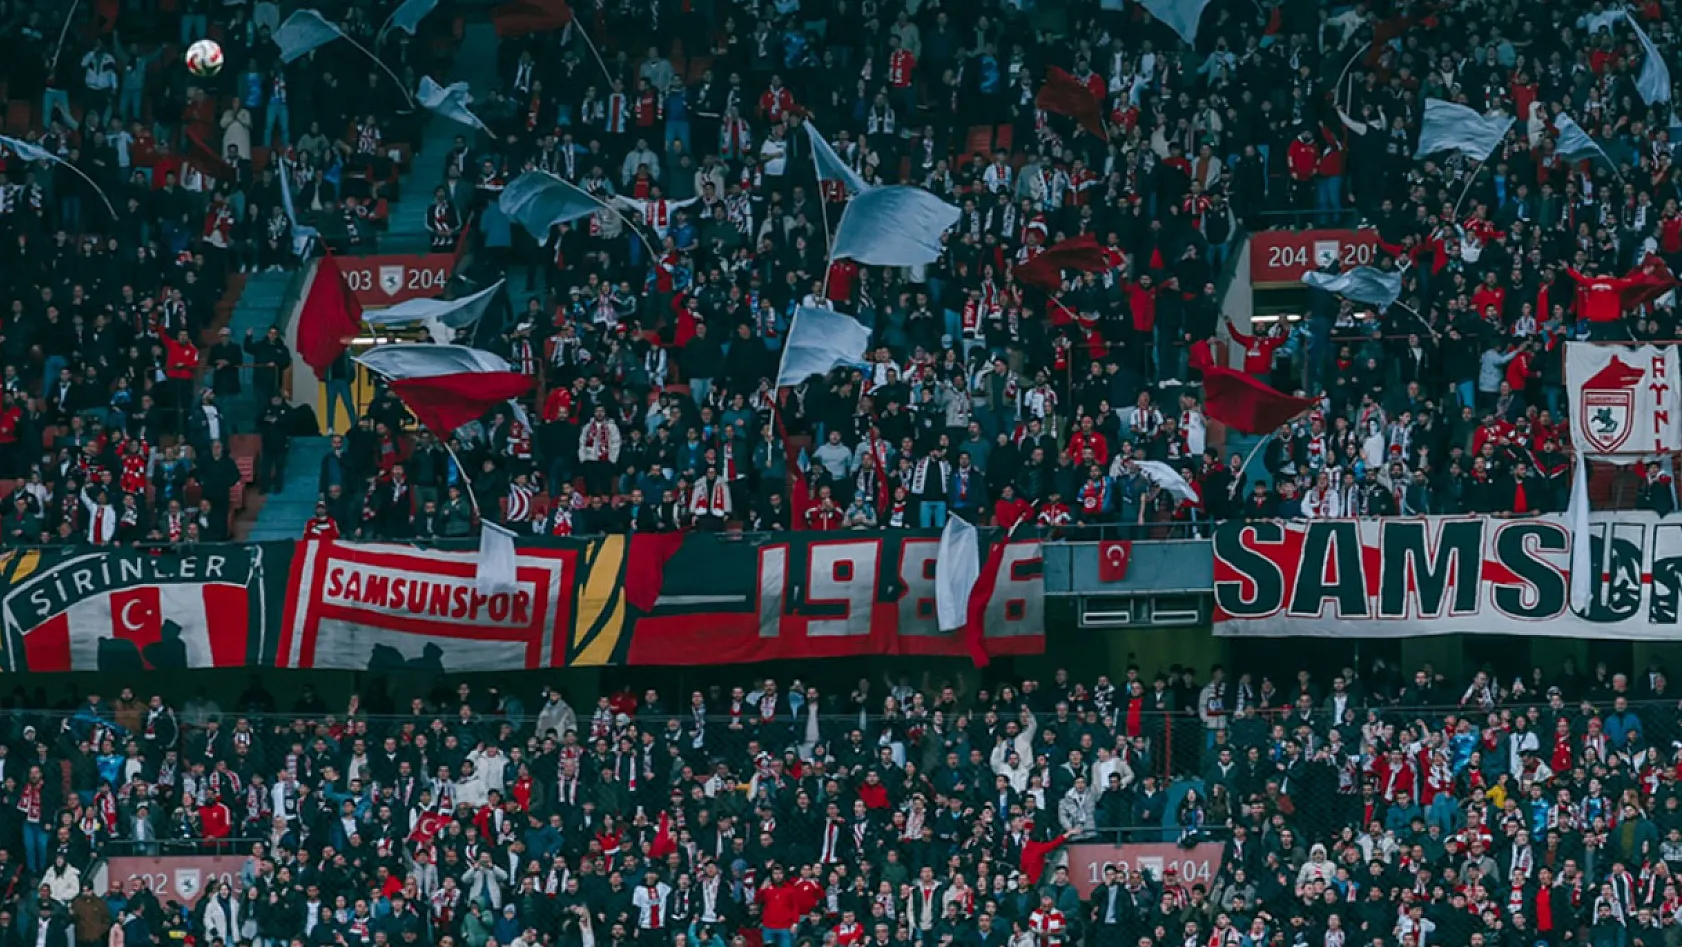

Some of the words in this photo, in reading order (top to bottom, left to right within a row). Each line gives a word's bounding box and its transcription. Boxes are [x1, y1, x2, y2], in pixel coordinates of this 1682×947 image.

[1268, 246, 1308, 267] 204
[341, 268, 372, 291] 03
[408, 268, 447, 290] 204
[327, 567, 529, 623] SAMSUNSPOR
[755, 537, 1044, 638] 1986
